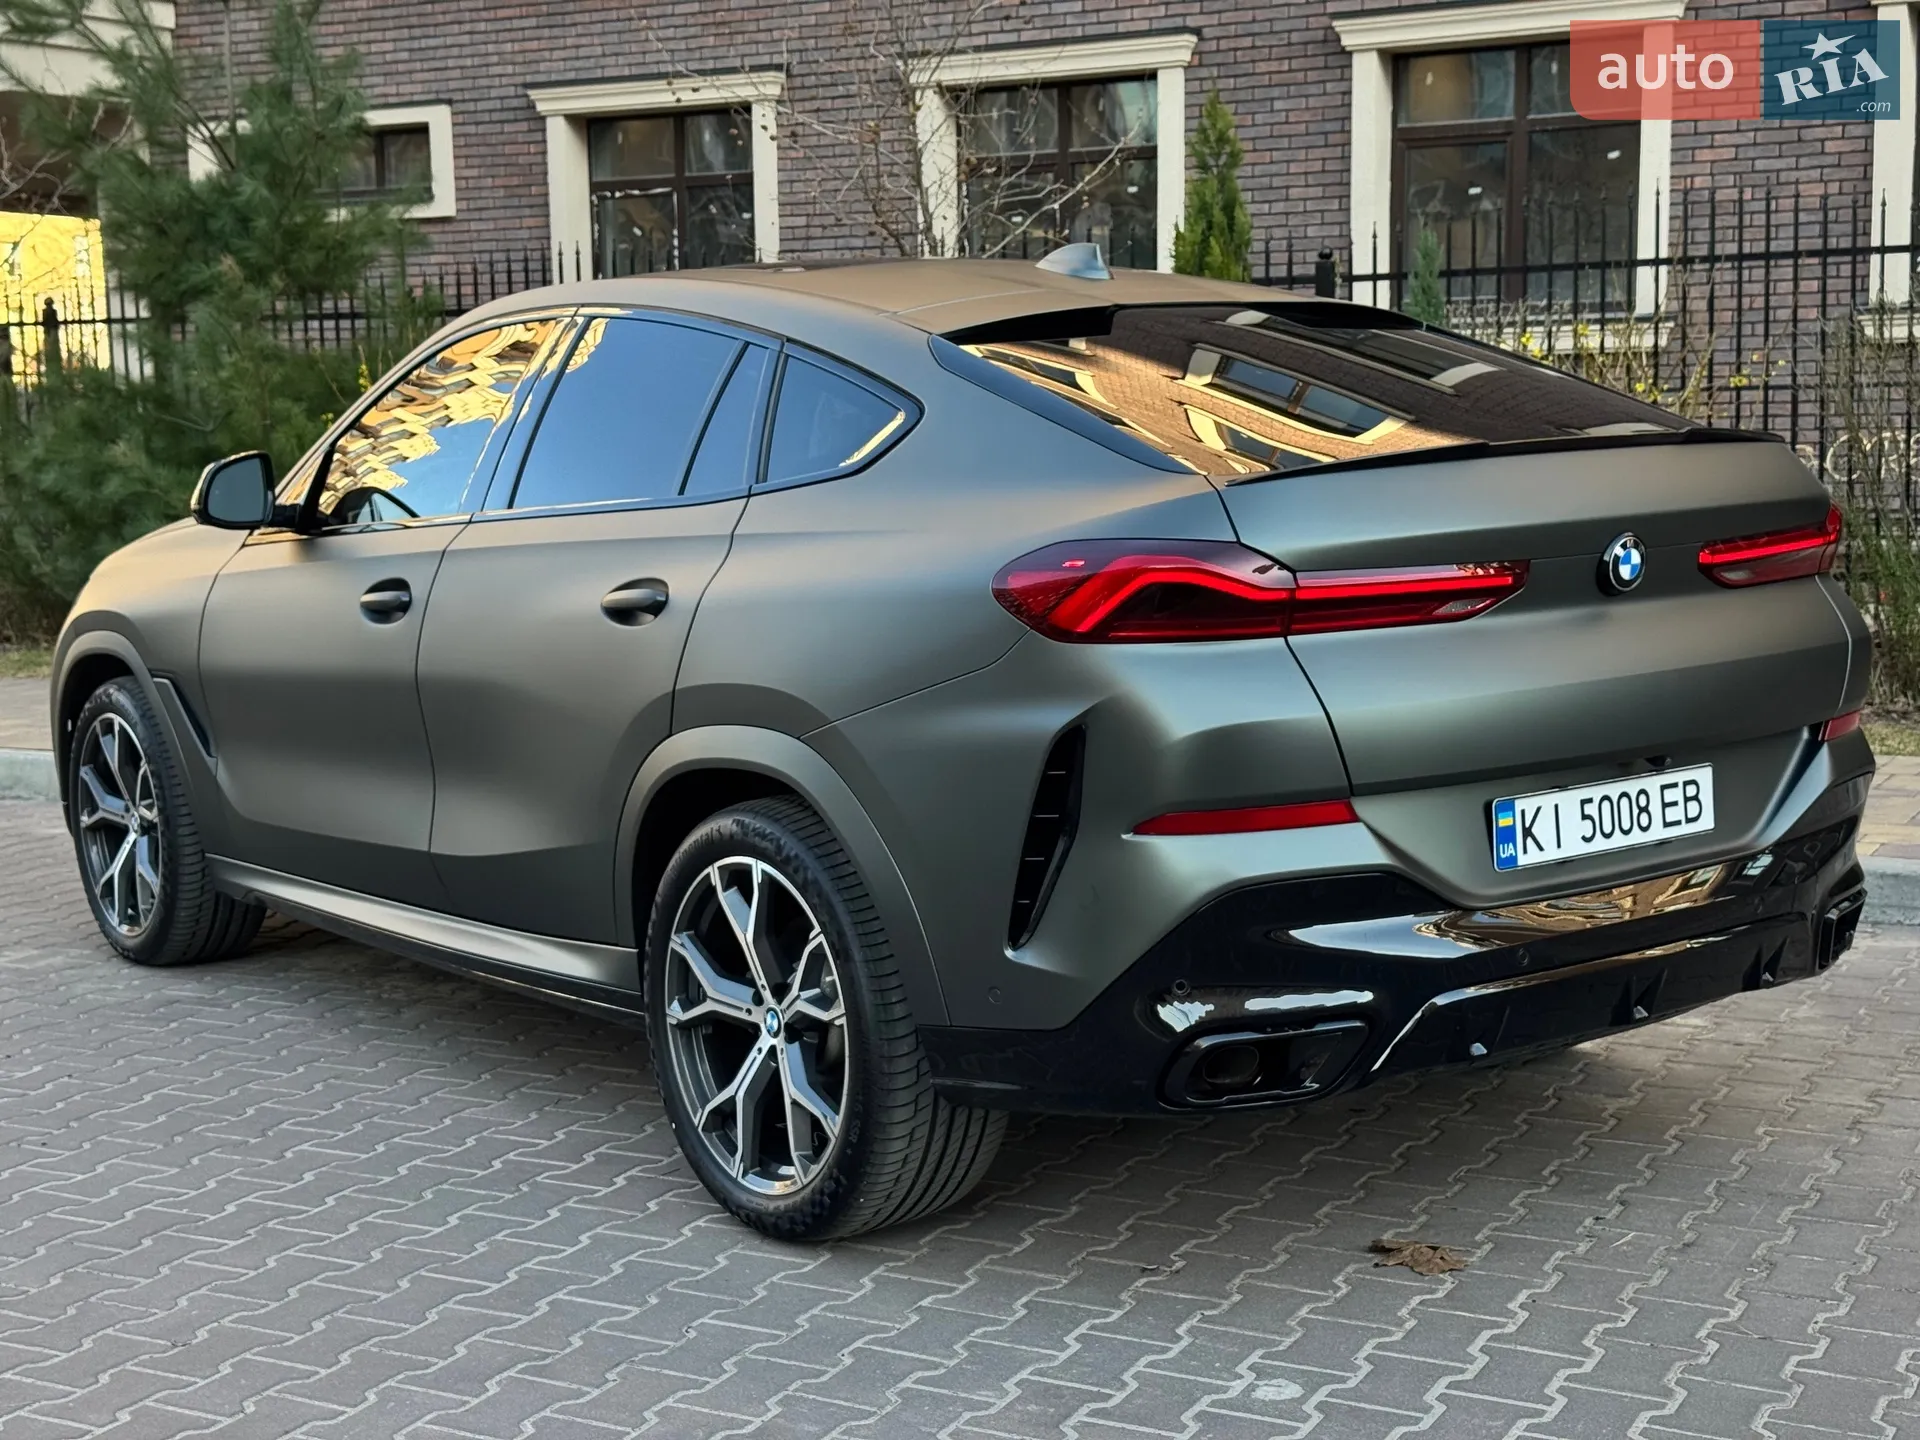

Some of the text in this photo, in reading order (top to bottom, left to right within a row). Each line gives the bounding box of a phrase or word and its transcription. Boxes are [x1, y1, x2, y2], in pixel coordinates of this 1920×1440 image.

[1520, 779, 1703, 855] KI 5008 EB
[1500, 842, 1516, 858] UA
